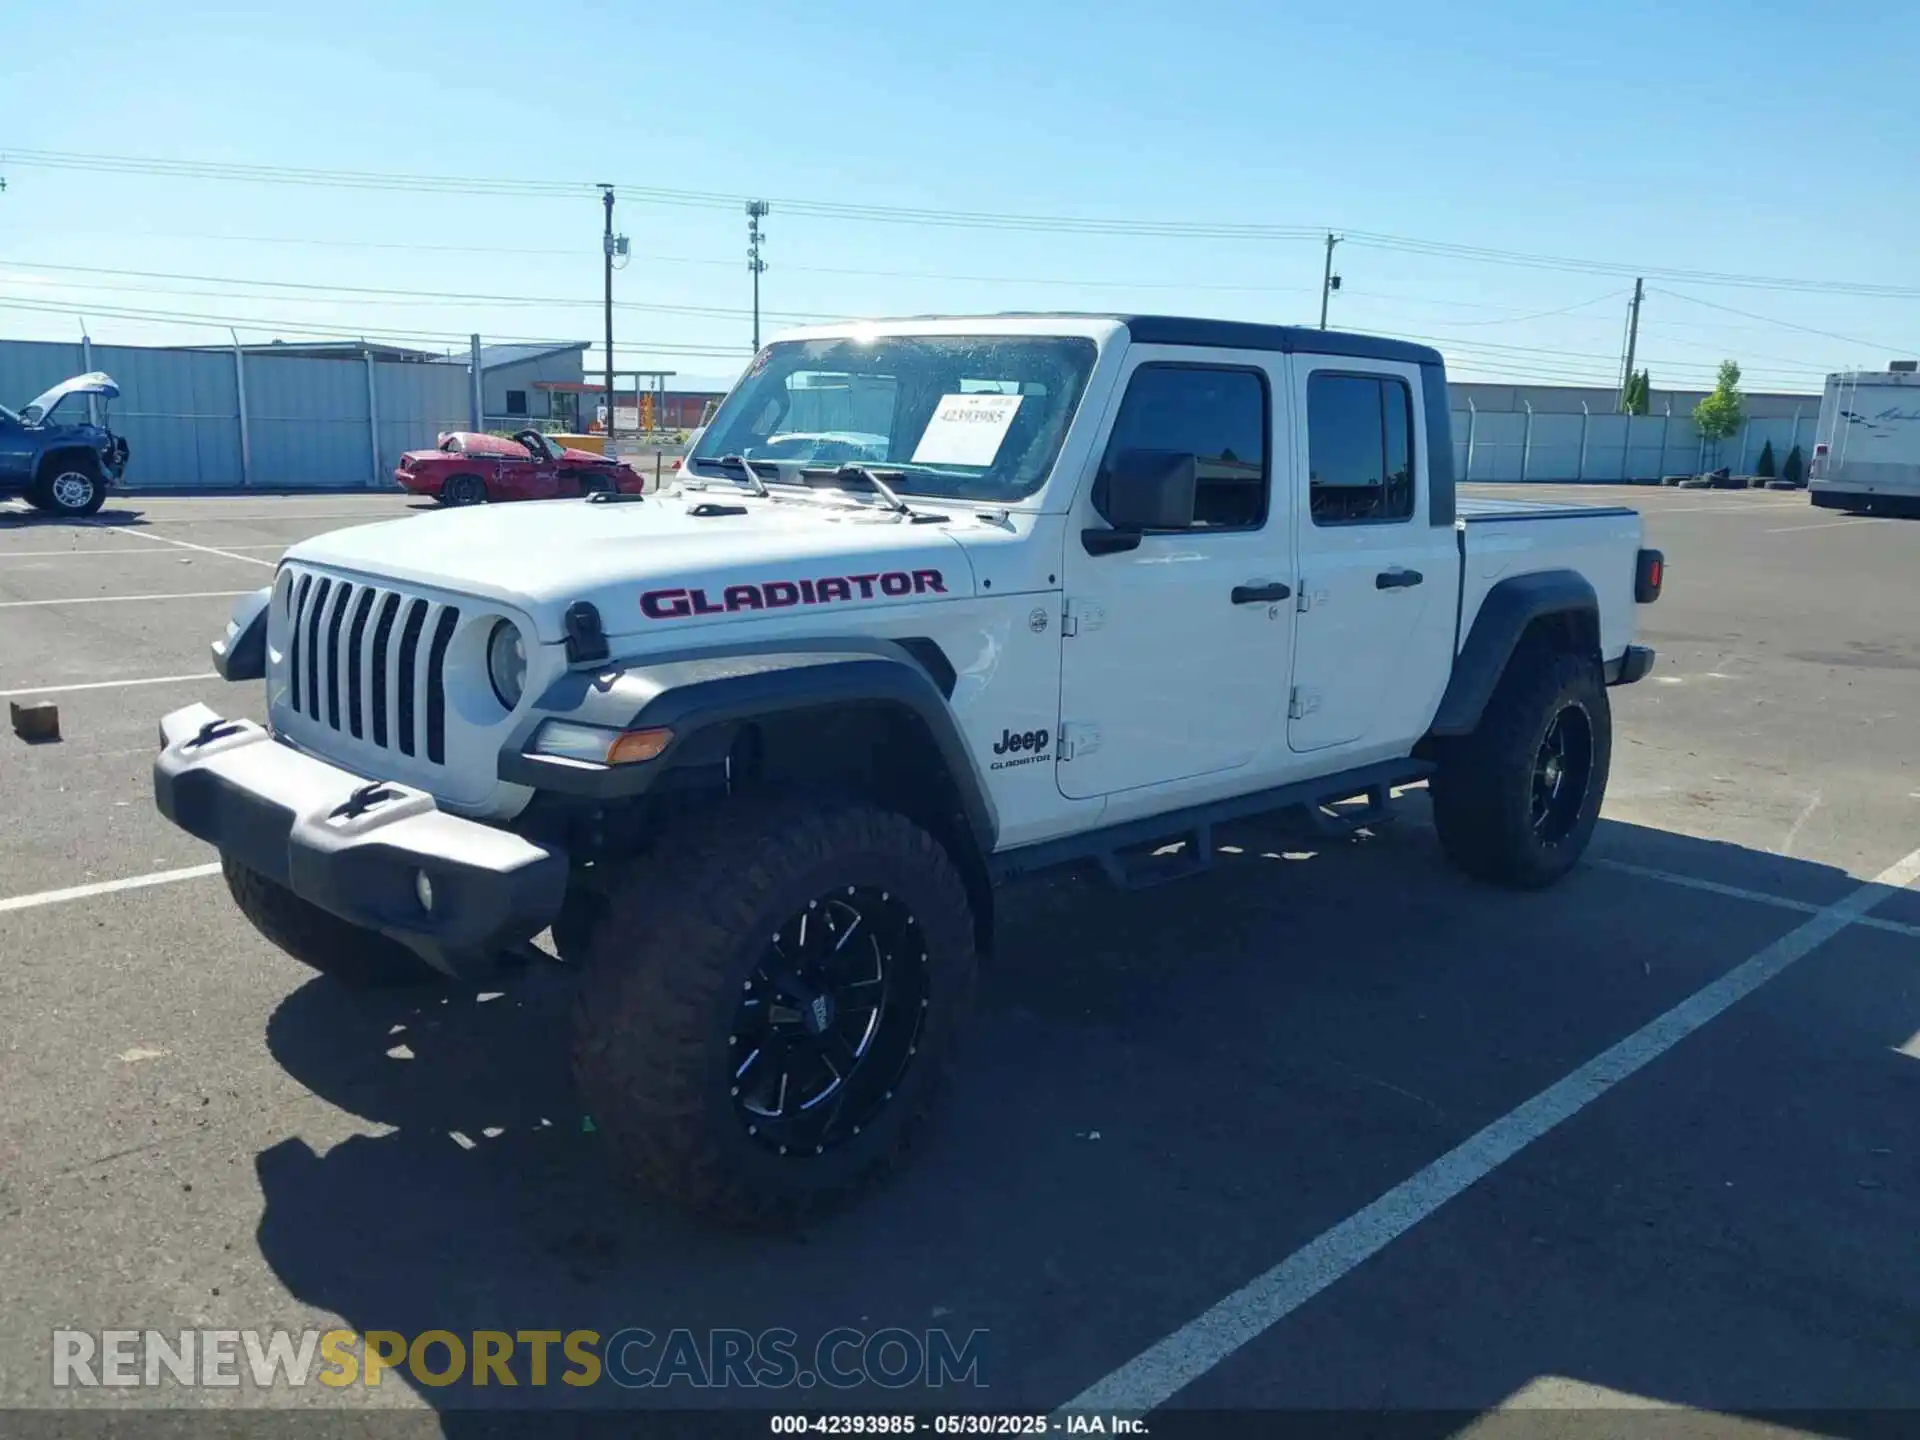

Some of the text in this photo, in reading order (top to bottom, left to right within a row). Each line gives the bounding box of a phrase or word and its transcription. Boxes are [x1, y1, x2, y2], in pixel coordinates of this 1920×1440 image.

[640, 569, 948, 619] GLADIATOR
[993, 729, 1049, 754] Jeep
[990, 754, 1051, 770] GLADIATOR
